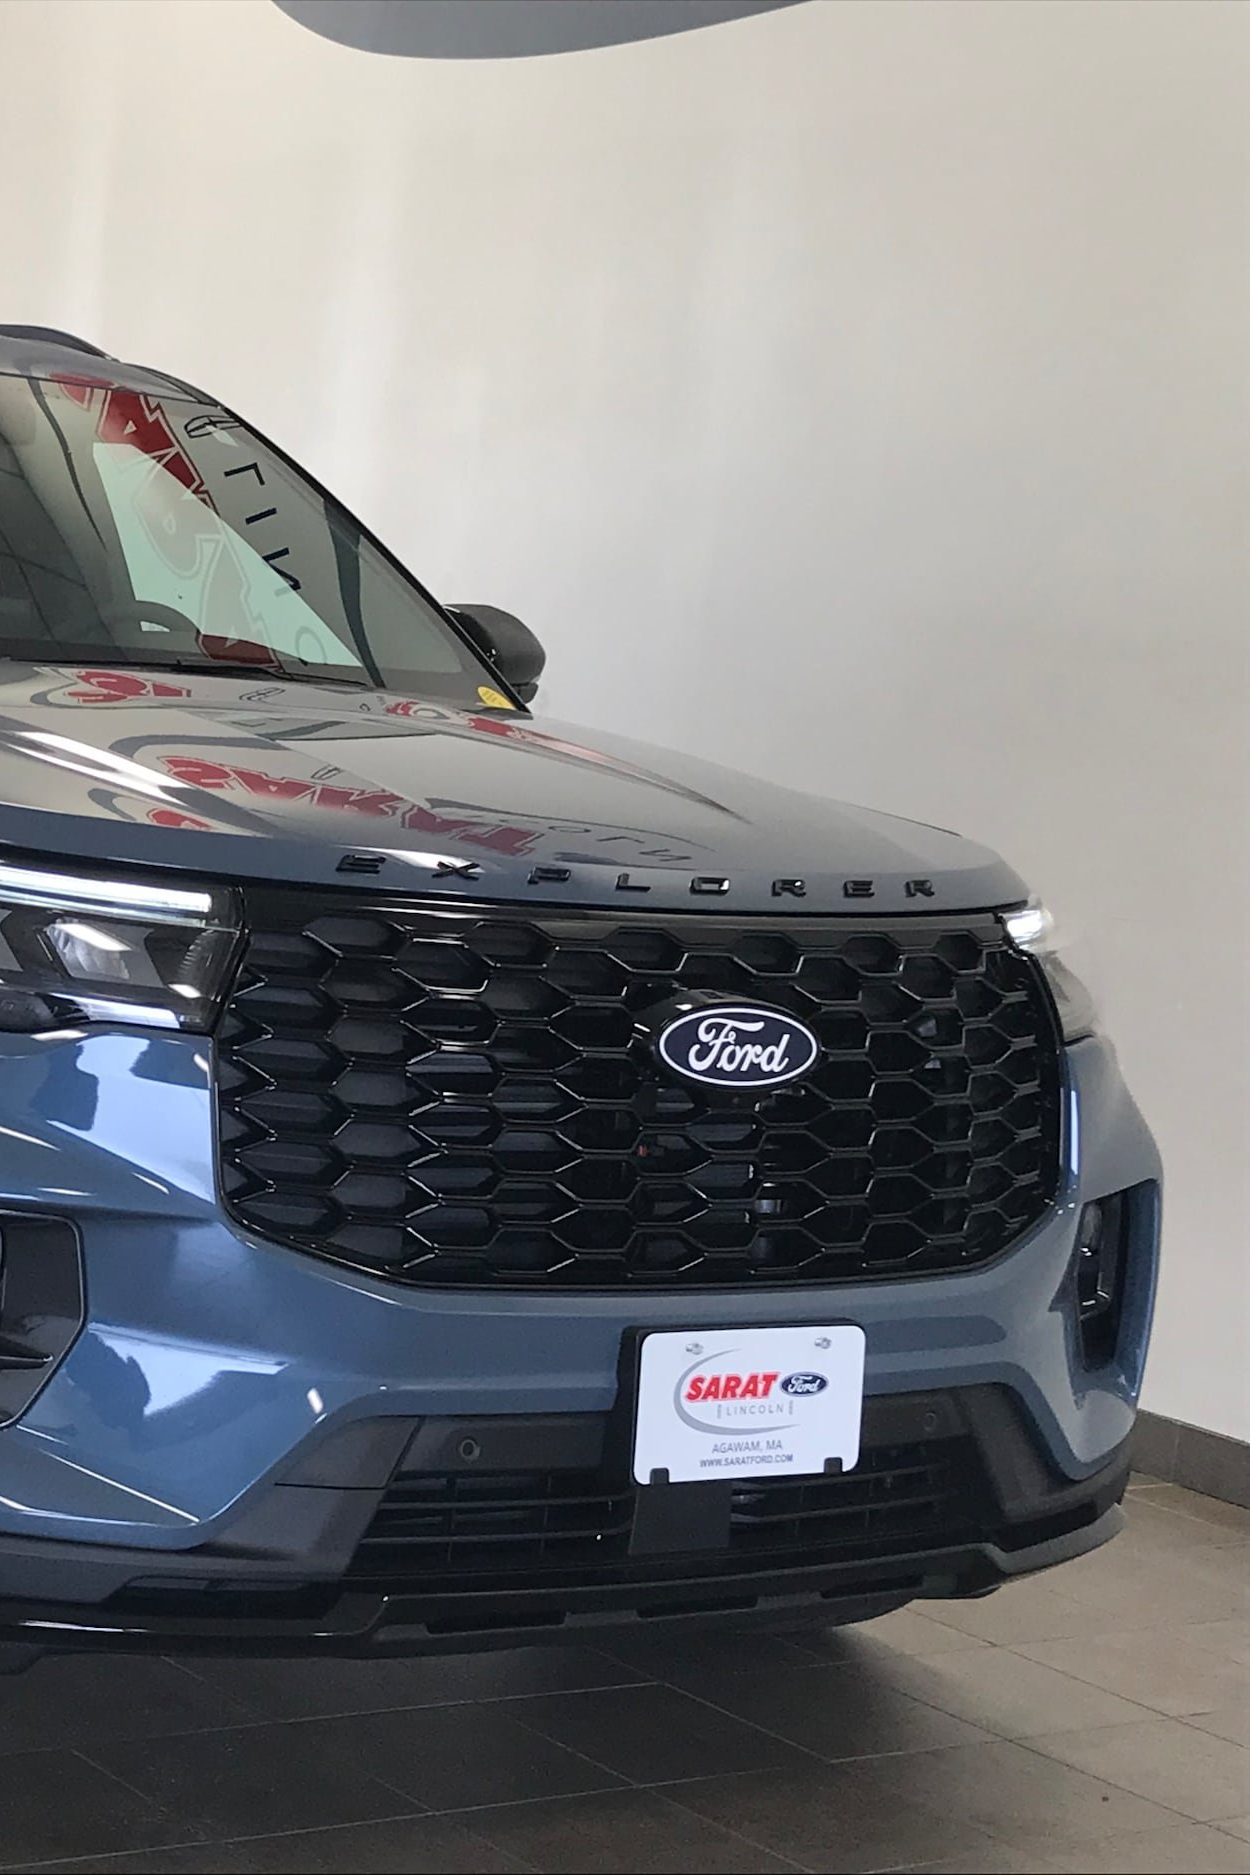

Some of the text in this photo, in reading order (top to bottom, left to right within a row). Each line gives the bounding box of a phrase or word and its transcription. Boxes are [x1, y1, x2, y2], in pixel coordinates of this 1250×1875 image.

[336, 854, 935, 897] EXPLORER
[688, 1018, 790, 1073] Ford
[685, 1371, 780, 1402] SARAT
[726, 1404, 784, 1417] LINCOLN
[712, 1439, 783, 1455] AGAWAM, MA
[699, 1453, 794, 1468] WWW.SARATFORD.COM
